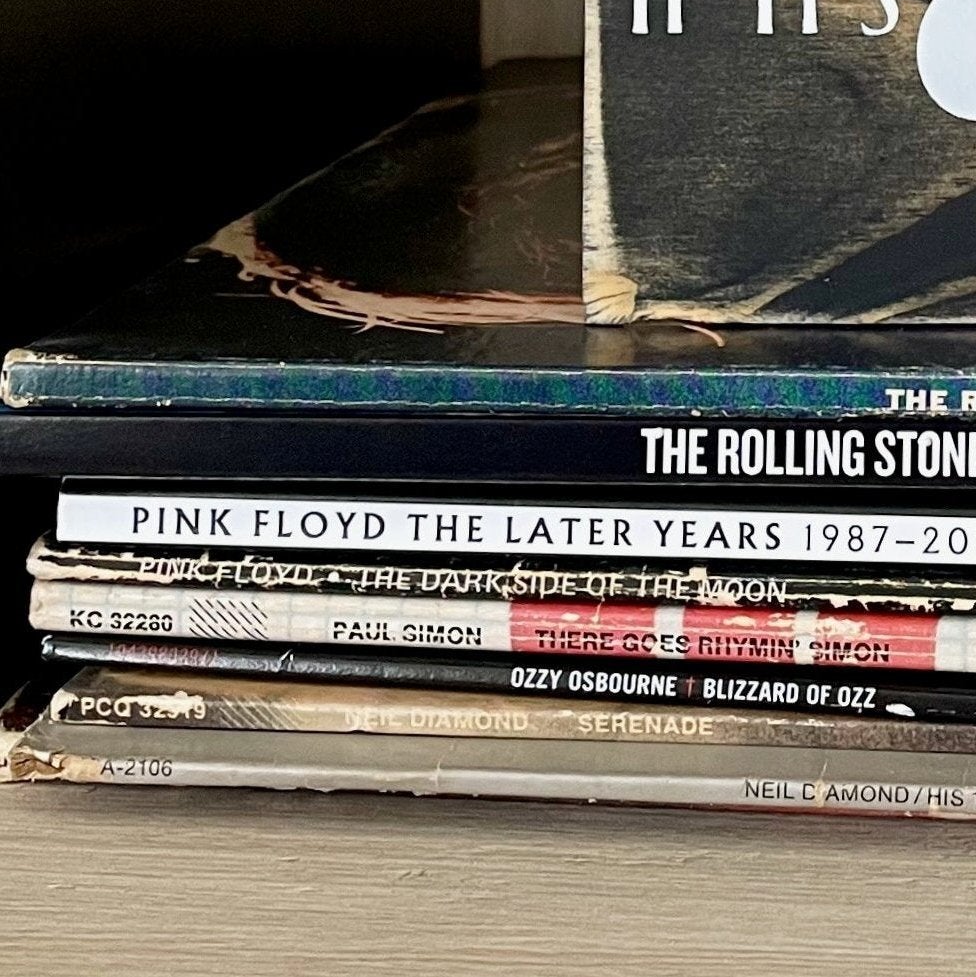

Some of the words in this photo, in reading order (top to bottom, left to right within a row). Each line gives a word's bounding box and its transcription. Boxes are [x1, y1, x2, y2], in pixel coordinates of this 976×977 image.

[885, 388, 948, 412] THE
[640, 427, 708, 474] THE
[717, 428, 865, 476] ROLLING
[132, 506, 232, 535] PINK
[253, 509, 386, 540] FLOYD
[407, 513, 484, 543] THE
[506, 515, 633, 547] LATER
[653, 520, 781, 551] YEARS
[139, 557, 202, 580] PINK
[216, 561, 314, 586] FLOYD
[359, 566, 412, 590] THE
[420, 569, 501, 595] DARK
[513, 572, 577, 599] SIDE
[586, 574, 622, 597] OF
[638, 575, 690, 600] THE
[702, 577, 788, 604] MOON
[70, 610, 103, 629] KC
[110, 612, 173, 632] 32280
[334, 621, 391, 642] PAUL
[402, 624, 483, 646] SIMON
[535, 629, 615, 651] THERE
[622, 633, 691, 654] GOES
[809, 641, 890, 663] SIMON
[510, 667, 563, 690] OZZY
[568, 670, 678, 697] OSBOURNE
[703, 678, 799, 704] BLIZZARD
[806, 684, 831, 706] OF
[837, 686, 876, 709] OZZ
[138, 694, 207, 720] 329
[345, 709, 402, 728] NEIL
[409, 710, 529, 732] DIAMOND
[578, 713, 714, 736] SERENADE
[100, 759, 173, 777] A-2106
[744, 779, 795, 800] NEIL
